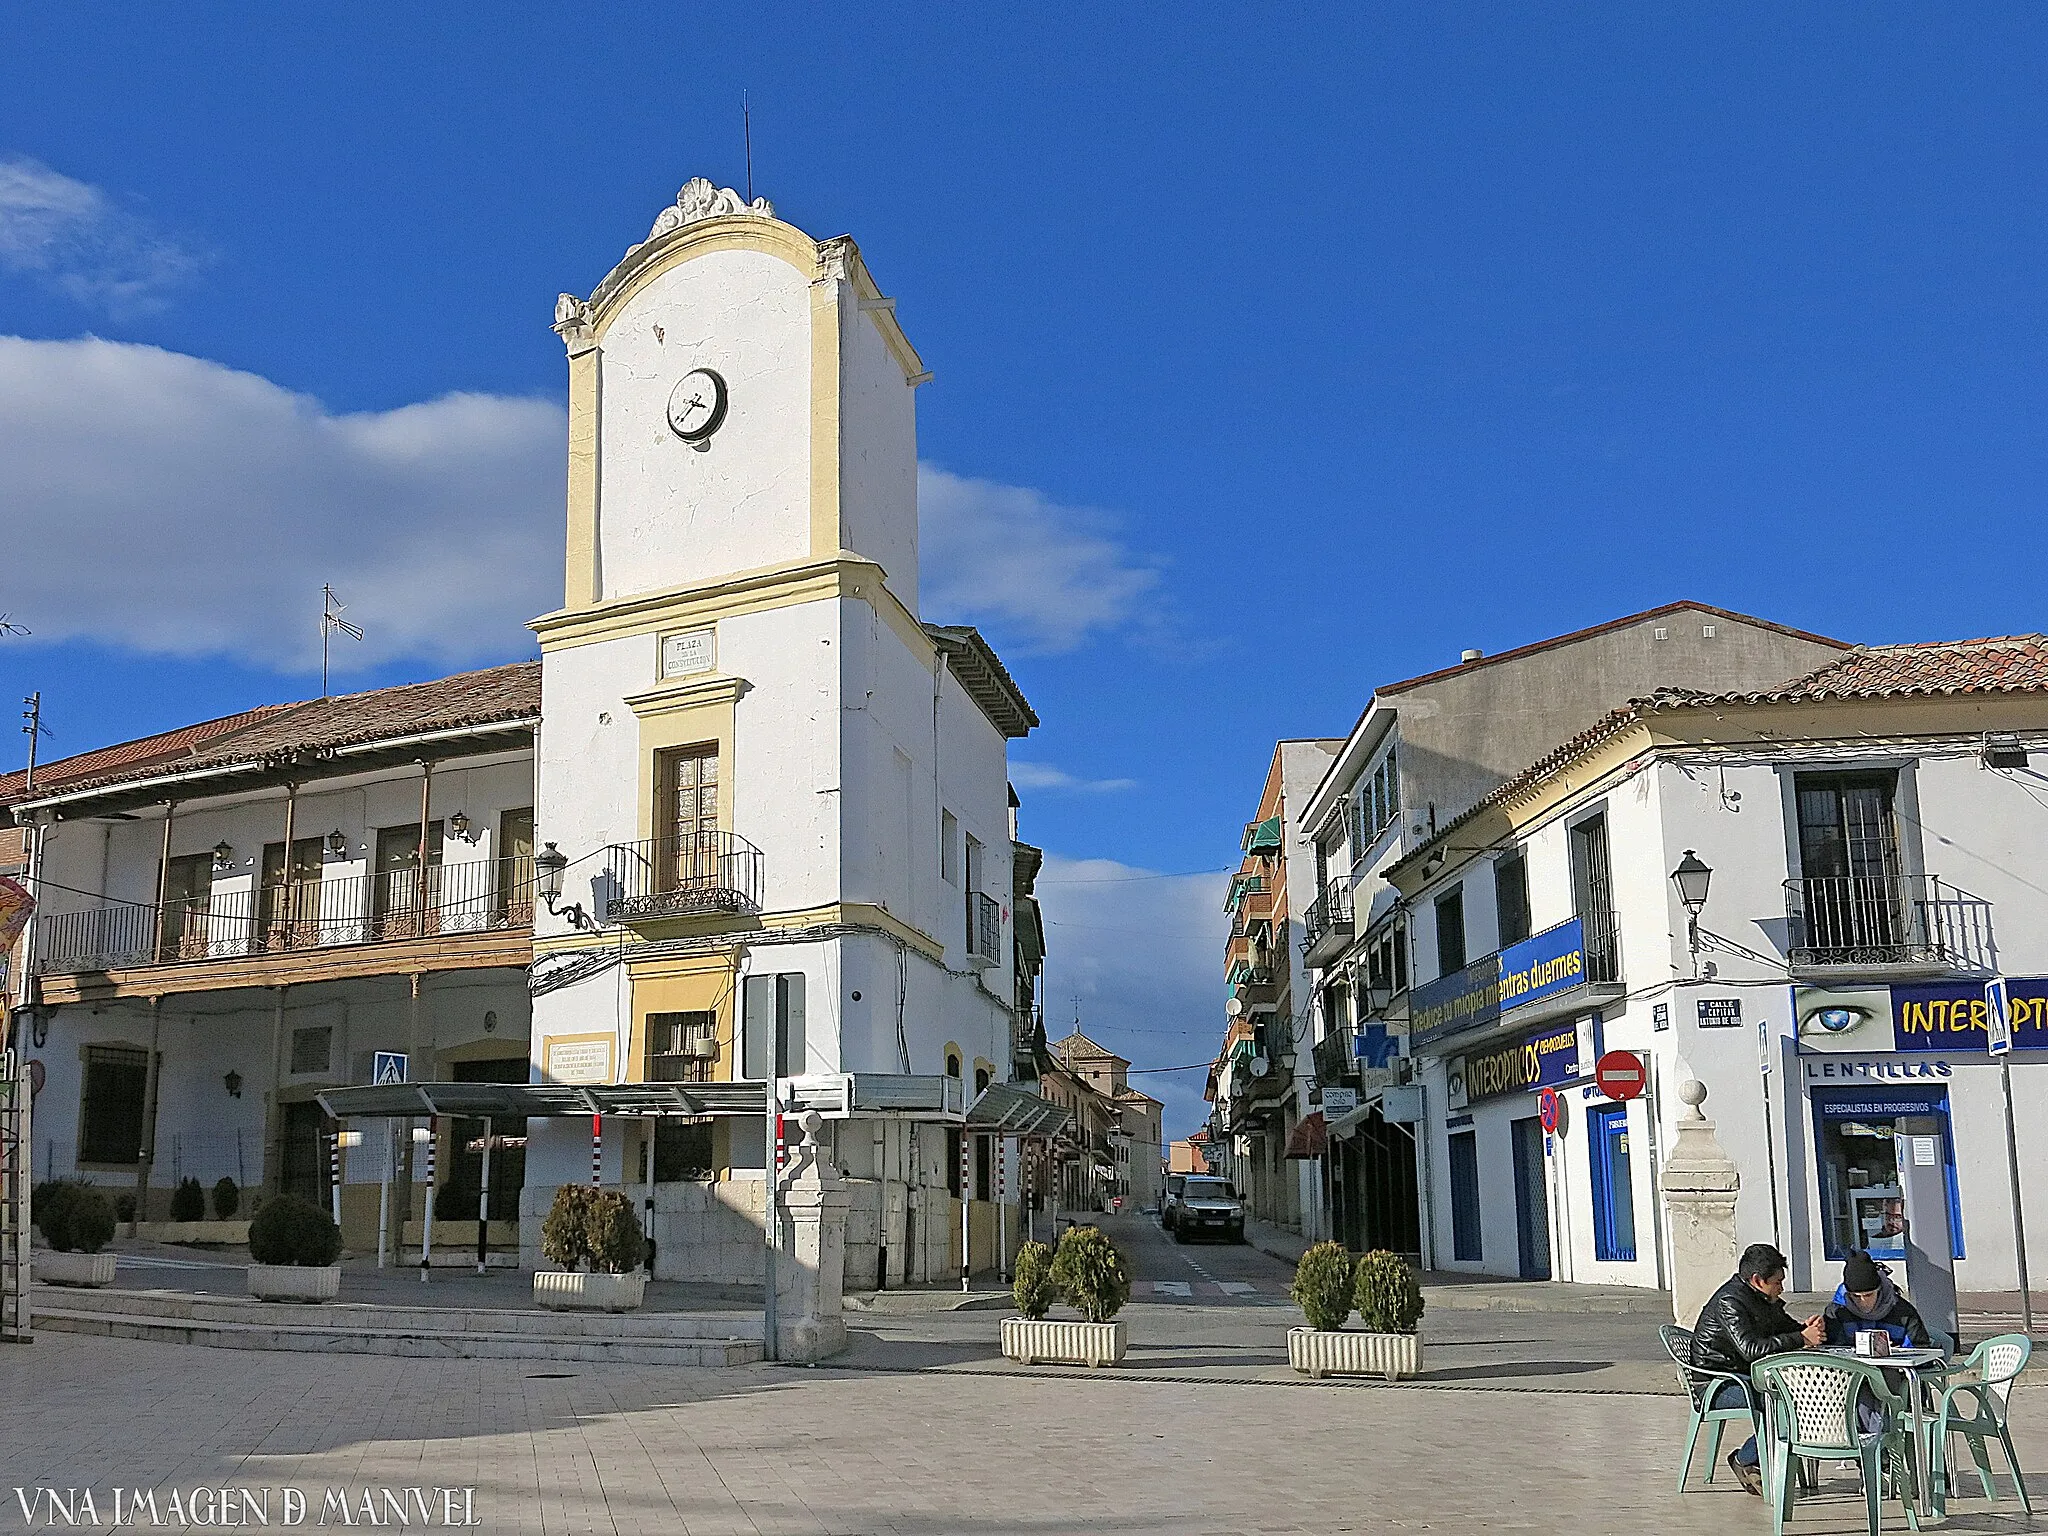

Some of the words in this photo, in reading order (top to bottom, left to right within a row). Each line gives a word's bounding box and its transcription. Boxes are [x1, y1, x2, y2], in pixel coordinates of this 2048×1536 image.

[676, 640, 702, 651] PLAZA
[1412, 1005, 1443, 1034] Reduce
[1444, 1000, 1453, 1022] tu
[1485, 971, 1529, 1007] mientras
[1530, 950, 1581, 990] duermes
[1902, 997, 2048, 1034] INTERPT
[1468, 1039, 1541, 1099] INTEROPTICOS
[1807, 1060, 1953, 1078] LENTILLAS
[1824, 1103, 1873, 1114] ESPECIALISTAS
[1873, 1103, 1883, 1113] EN
[1883, 1102, 1930, 1113] PROGRESIVOS
